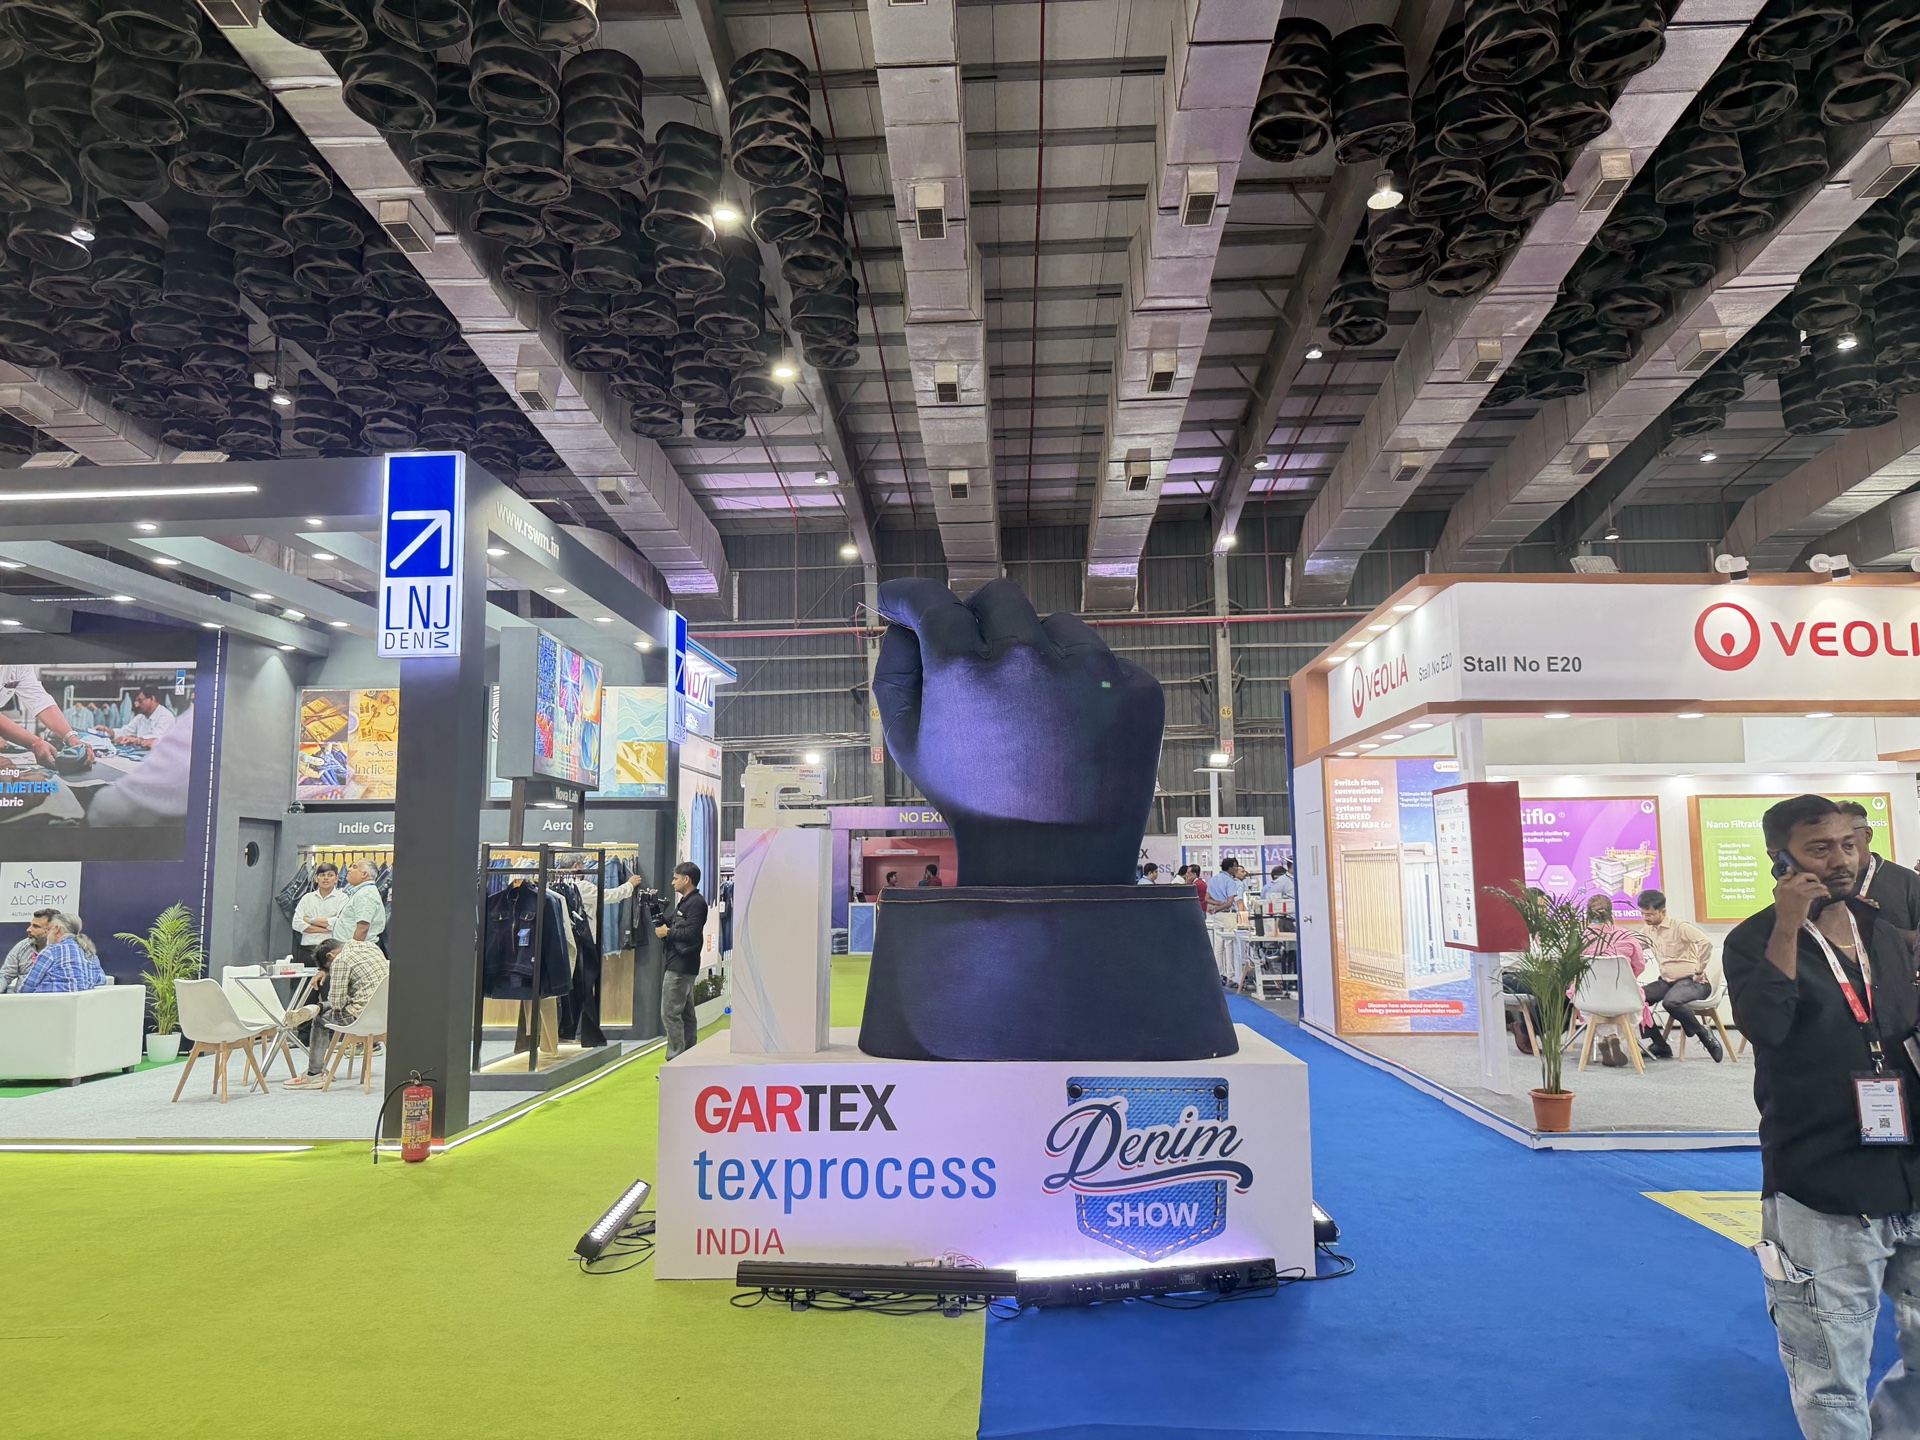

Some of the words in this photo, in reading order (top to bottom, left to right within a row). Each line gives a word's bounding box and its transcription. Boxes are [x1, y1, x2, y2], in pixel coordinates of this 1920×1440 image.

[496, 501, 560, 560] www.rswm.in
[385, 585, 451, 630] LNJ
[384, 632, 450, 650] DENIM
[1770, 620, 1920, 657] VEOLI
[1418, 661, 1431, 682] Stall
[1431, 658, 1440, 675] No
[1441, 652, 1453, 672] E20
[1463, 656, 1507, 673] Stall
[1514, 656, 1540, 673] No
[1547, 656, 1582, 673] E20
[1365, 653, 1409, 702] VEOLIA
[0, 768, 20, 778] cing
[6, 781, 59, 794] METERS
[1333, 779, 1360, 787] Switch
[1360, 779, 1380, 787] from
[1334, 787, 1384, 795] conventional
[555, 786, 568, 802] Nova
[568, 789, 579, 804] Lab
[899, 811, 919, 823] NO
[921, 811, 943, 823] EXI
[1335, 805, 1362, 813] system
[1520, 808, 1556, 825] tiflo
[338, 822, 370, 834] Indie
[373, 822, 396, 834] Cra
[1229, 823, 1256, 831] TUREL
[1361, 821, 1380, 829] MBR
[1381, 821, 1393, 829] for
[1706, 820, 1730, 829] Nano
[10, 894, 68, 906] ALCHEMY
[694, 1084, 898, 1133] GARTEX
[1042, 1101, 1253, 1193] Denim
[693, 1150, 997, 1214] texprocess
[1106, 1202, 1199, 1227] SHOW
[696, 1228, 785, 1255] INDIA
